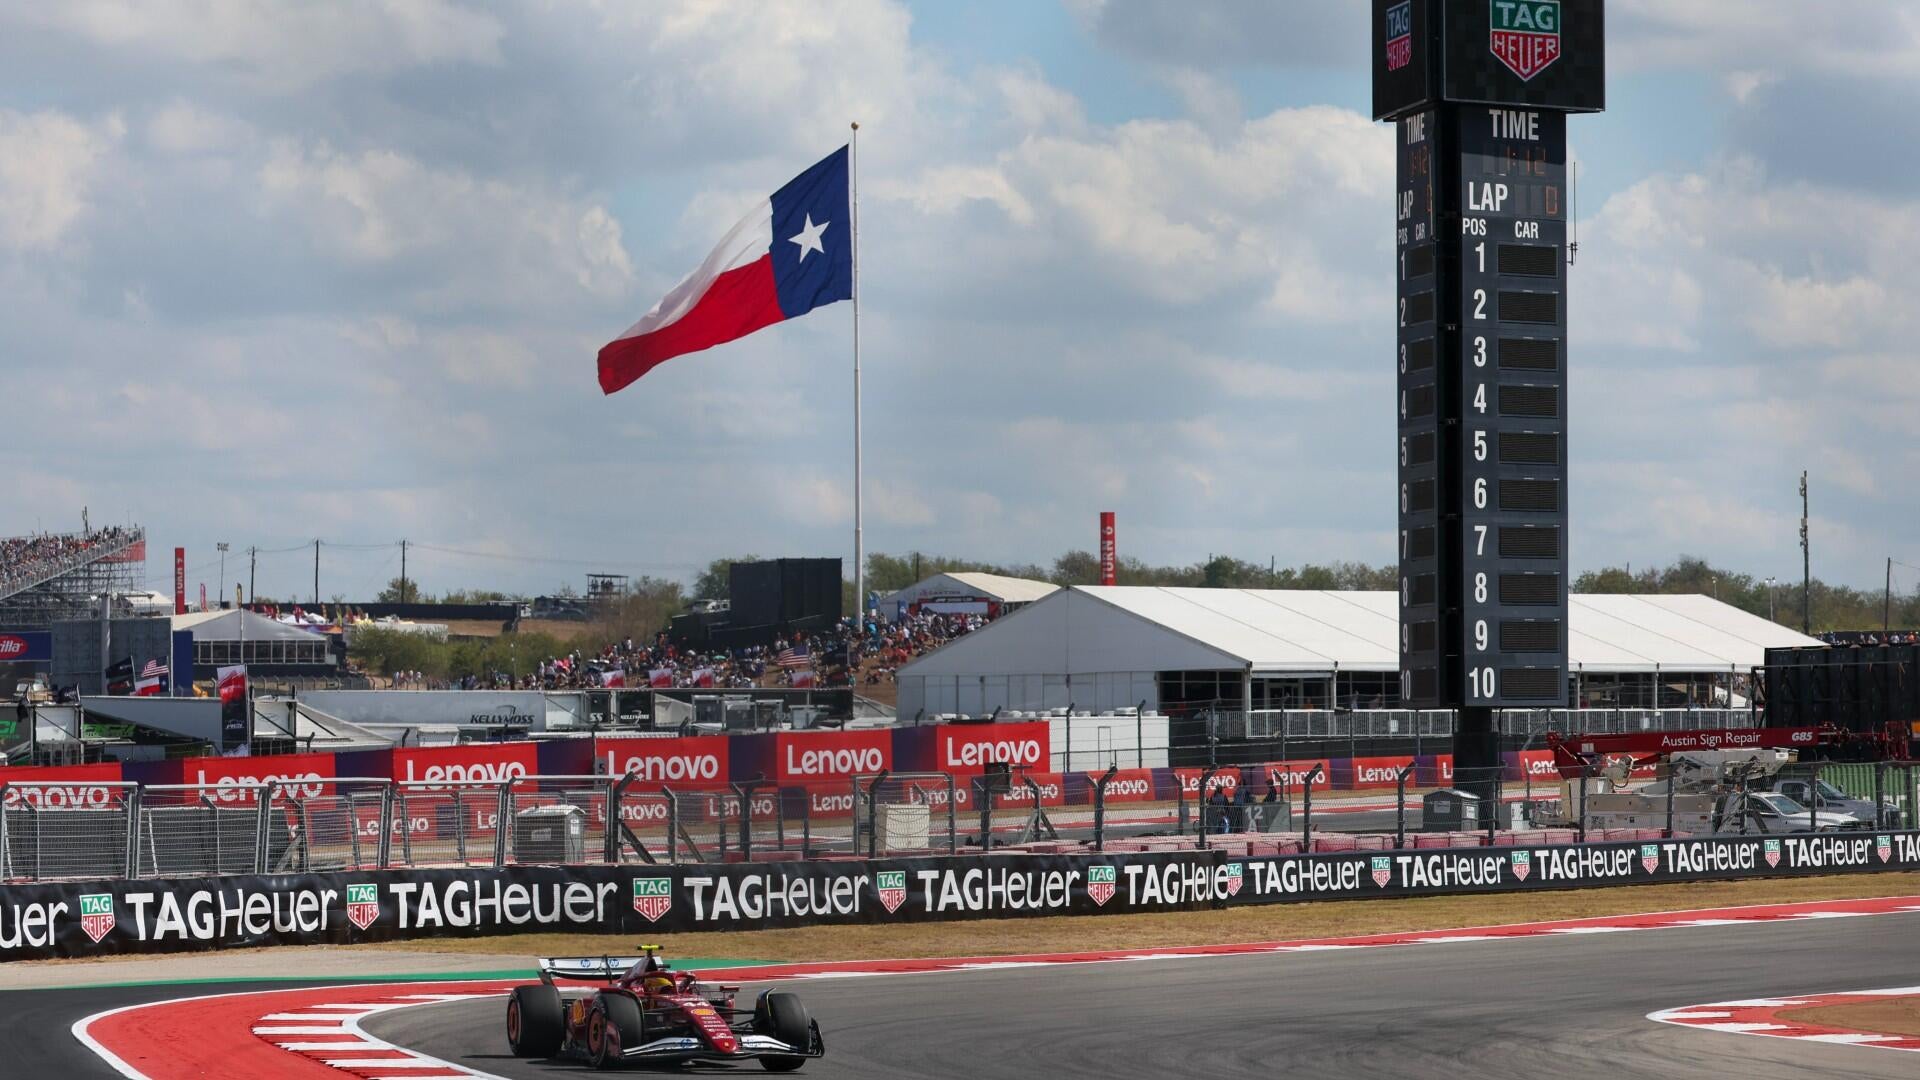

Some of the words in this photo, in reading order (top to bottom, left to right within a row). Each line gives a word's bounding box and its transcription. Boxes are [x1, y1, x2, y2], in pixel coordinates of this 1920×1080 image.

[1388, 6, 1408, 38] TAG
[1496, 1, 1554, 30] TAG
[1494, 34, 1556, 75] HEUER
[1405, 112, 1425, 145] TIME
[1488, 109, 1540, 141] TIME
[1398, 190, 1414, 220] LAP
[1468, 181, 1508, 212] LAP
[1398, 228, 1408, 245] POS
[1415, 223, 1426, 241] CAR
[1462, 218, 1487, 236] POS
[1514, 221, 1539, 239] CAR
[1400, 251, 1406, 280] 1
[1475, 242, 1485, 273] 1
[1400, 298, 1406, 327] 2
[1473, 289, 1487, 320] 2
[1400, 344, 1407, 374] 3
[1473, 336, 1487, 367] 3
[1401, 390, 1407, 419] 4
[1473, 383, 1487, 413] 4
[1401, 437, 1407, 467] 5
[1474, 430, 1487, 461] 5
[1401, 483, 1408, 514] 6
[1474, 477, 1487, 509] 6
[1402, 530, 1408, 560] 7
[1474, 525, 1487, 555] 7
[1402, 576, 1408, 607] 8
[1474, 572, 1488, 603] 8
[0, 639, 21, 653] illa
[1402, 624, 1409, 653] 9
[1475, 619, 1488, 651] 9
[1400, 670, 1411, 700] 10
[1468, 667, 1496, 698] 10
[947, 737, 1041, 767] Lenovo
[1661, 735, 1697, 747] Austin
[1700, 733, 1722, 747] Sign
[1725, 732, 1762, 747] Repair
[608, 750, 719, 781] Lenovo
[787, 744, 883, 775] Lenovo
[1357, 765, 1409, 782] Lenov
[1525, 758, 1559, 775] Leno
[198, 769, 324, 802] Lenovo
[407, 759, 526, 791] Lenovo
[1094, 778, 1149, 796] enovo
[1181, 774, 1236, 792] Leovo
[1271, 768, 1326, 786] Lenoo
[4, 786, 110, 811] enovo
[598, 803, 667, 822] Lnovo
[709, 798, 773, 817] Lenvo
[1245, 805, 1264, 819] 12
[1642, 846, 1657, 856] TAG
[1766, 841, 1779, 850] TAG
[1878, 837, 1890, 846] TAG
[1227, 865, 1241, 876] AG
[1373, 859, 1389, 869] TAG
[1513, 852, 1528, 863] TAG
[636, 880, 669, 894] TAG
[879, 873, 903, 888] TAG
[1090, 868, 1114, 881] TAG
[83, 897, 110, 913] TAG
[349, 886, 375, 901] TAG
[880, 889, 905, 910] HEUER
[1088, 883, 1115, 904] HEUER
[348, 904, 379, 927] HEUER
[634, 897, 670, 920] HEUER
[82, 914, 114, 939] HEUER
